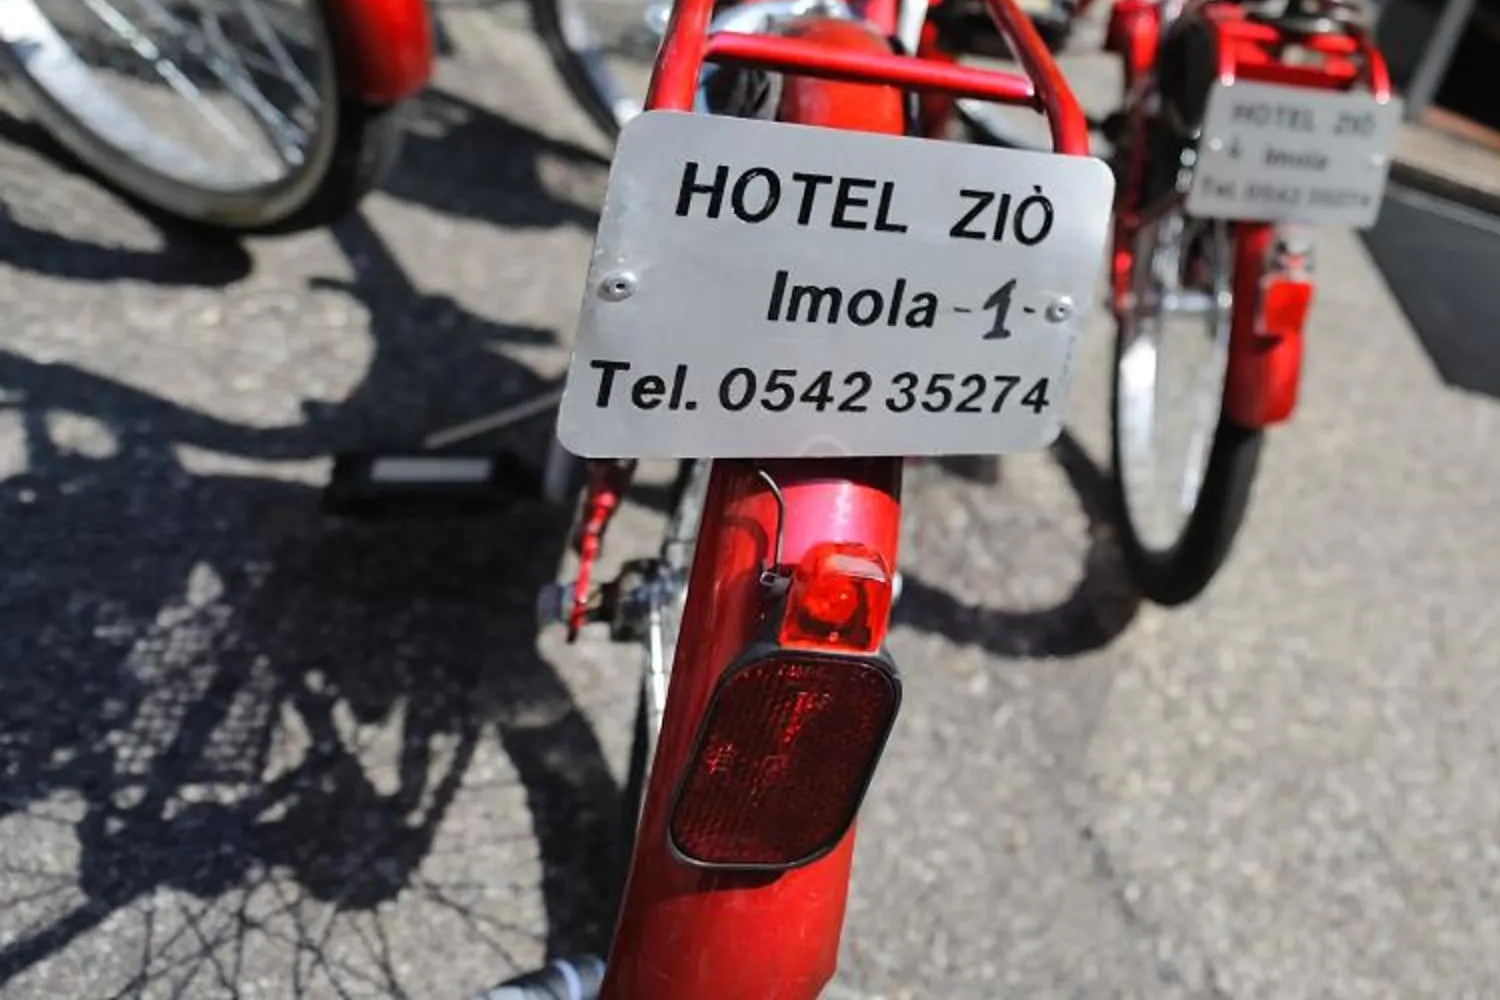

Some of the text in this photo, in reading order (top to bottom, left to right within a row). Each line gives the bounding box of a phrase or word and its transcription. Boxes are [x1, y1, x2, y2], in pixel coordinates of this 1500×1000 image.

[1233, 102, 1314, 133] HOTEL
[674, 161, 1054, 247] HOTEL ZIÒ
[766, 269, 939, 329] Imola
[589, 359, 1050, 415] Tel. 0542 35274
